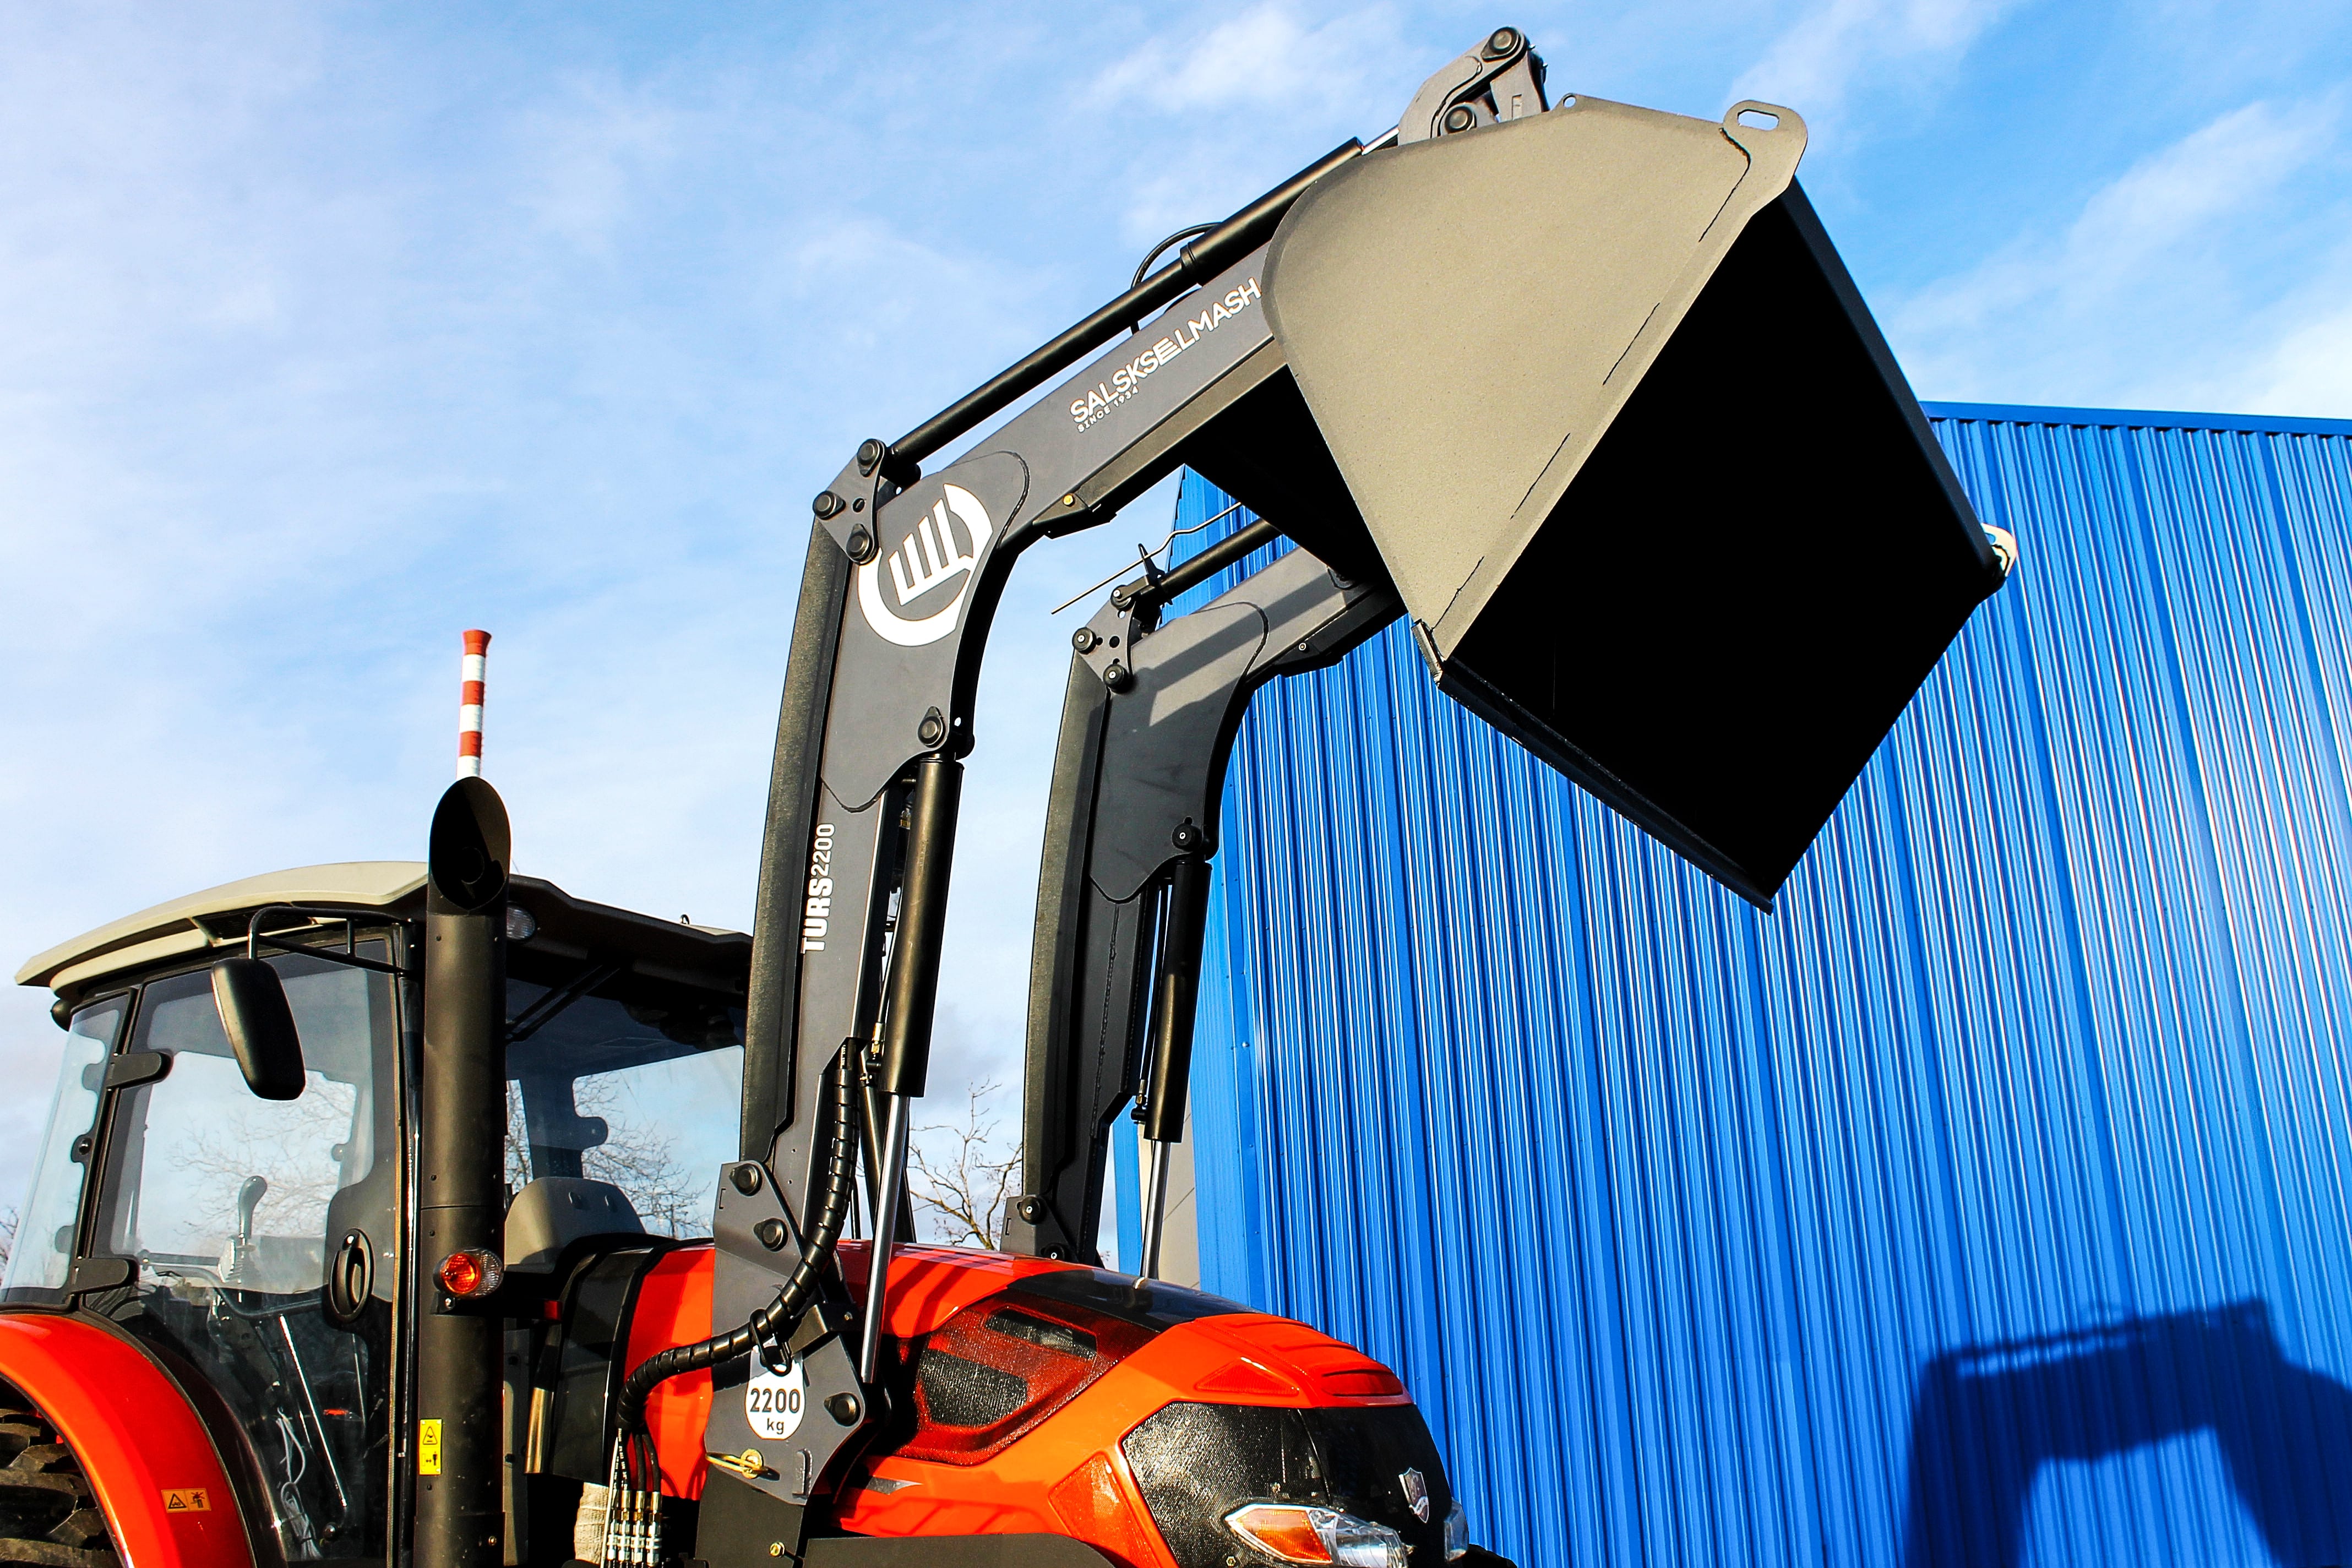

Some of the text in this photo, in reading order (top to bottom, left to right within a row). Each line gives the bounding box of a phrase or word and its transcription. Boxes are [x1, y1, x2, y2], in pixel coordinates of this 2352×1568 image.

[1070, 276, 1262, 423] SALSKSELMASH
[1077, 385, 1139, 433] SINCE 1934
[750, 1388, 801, 1414] 2200
[766, 1418, 785, 1435] kg
